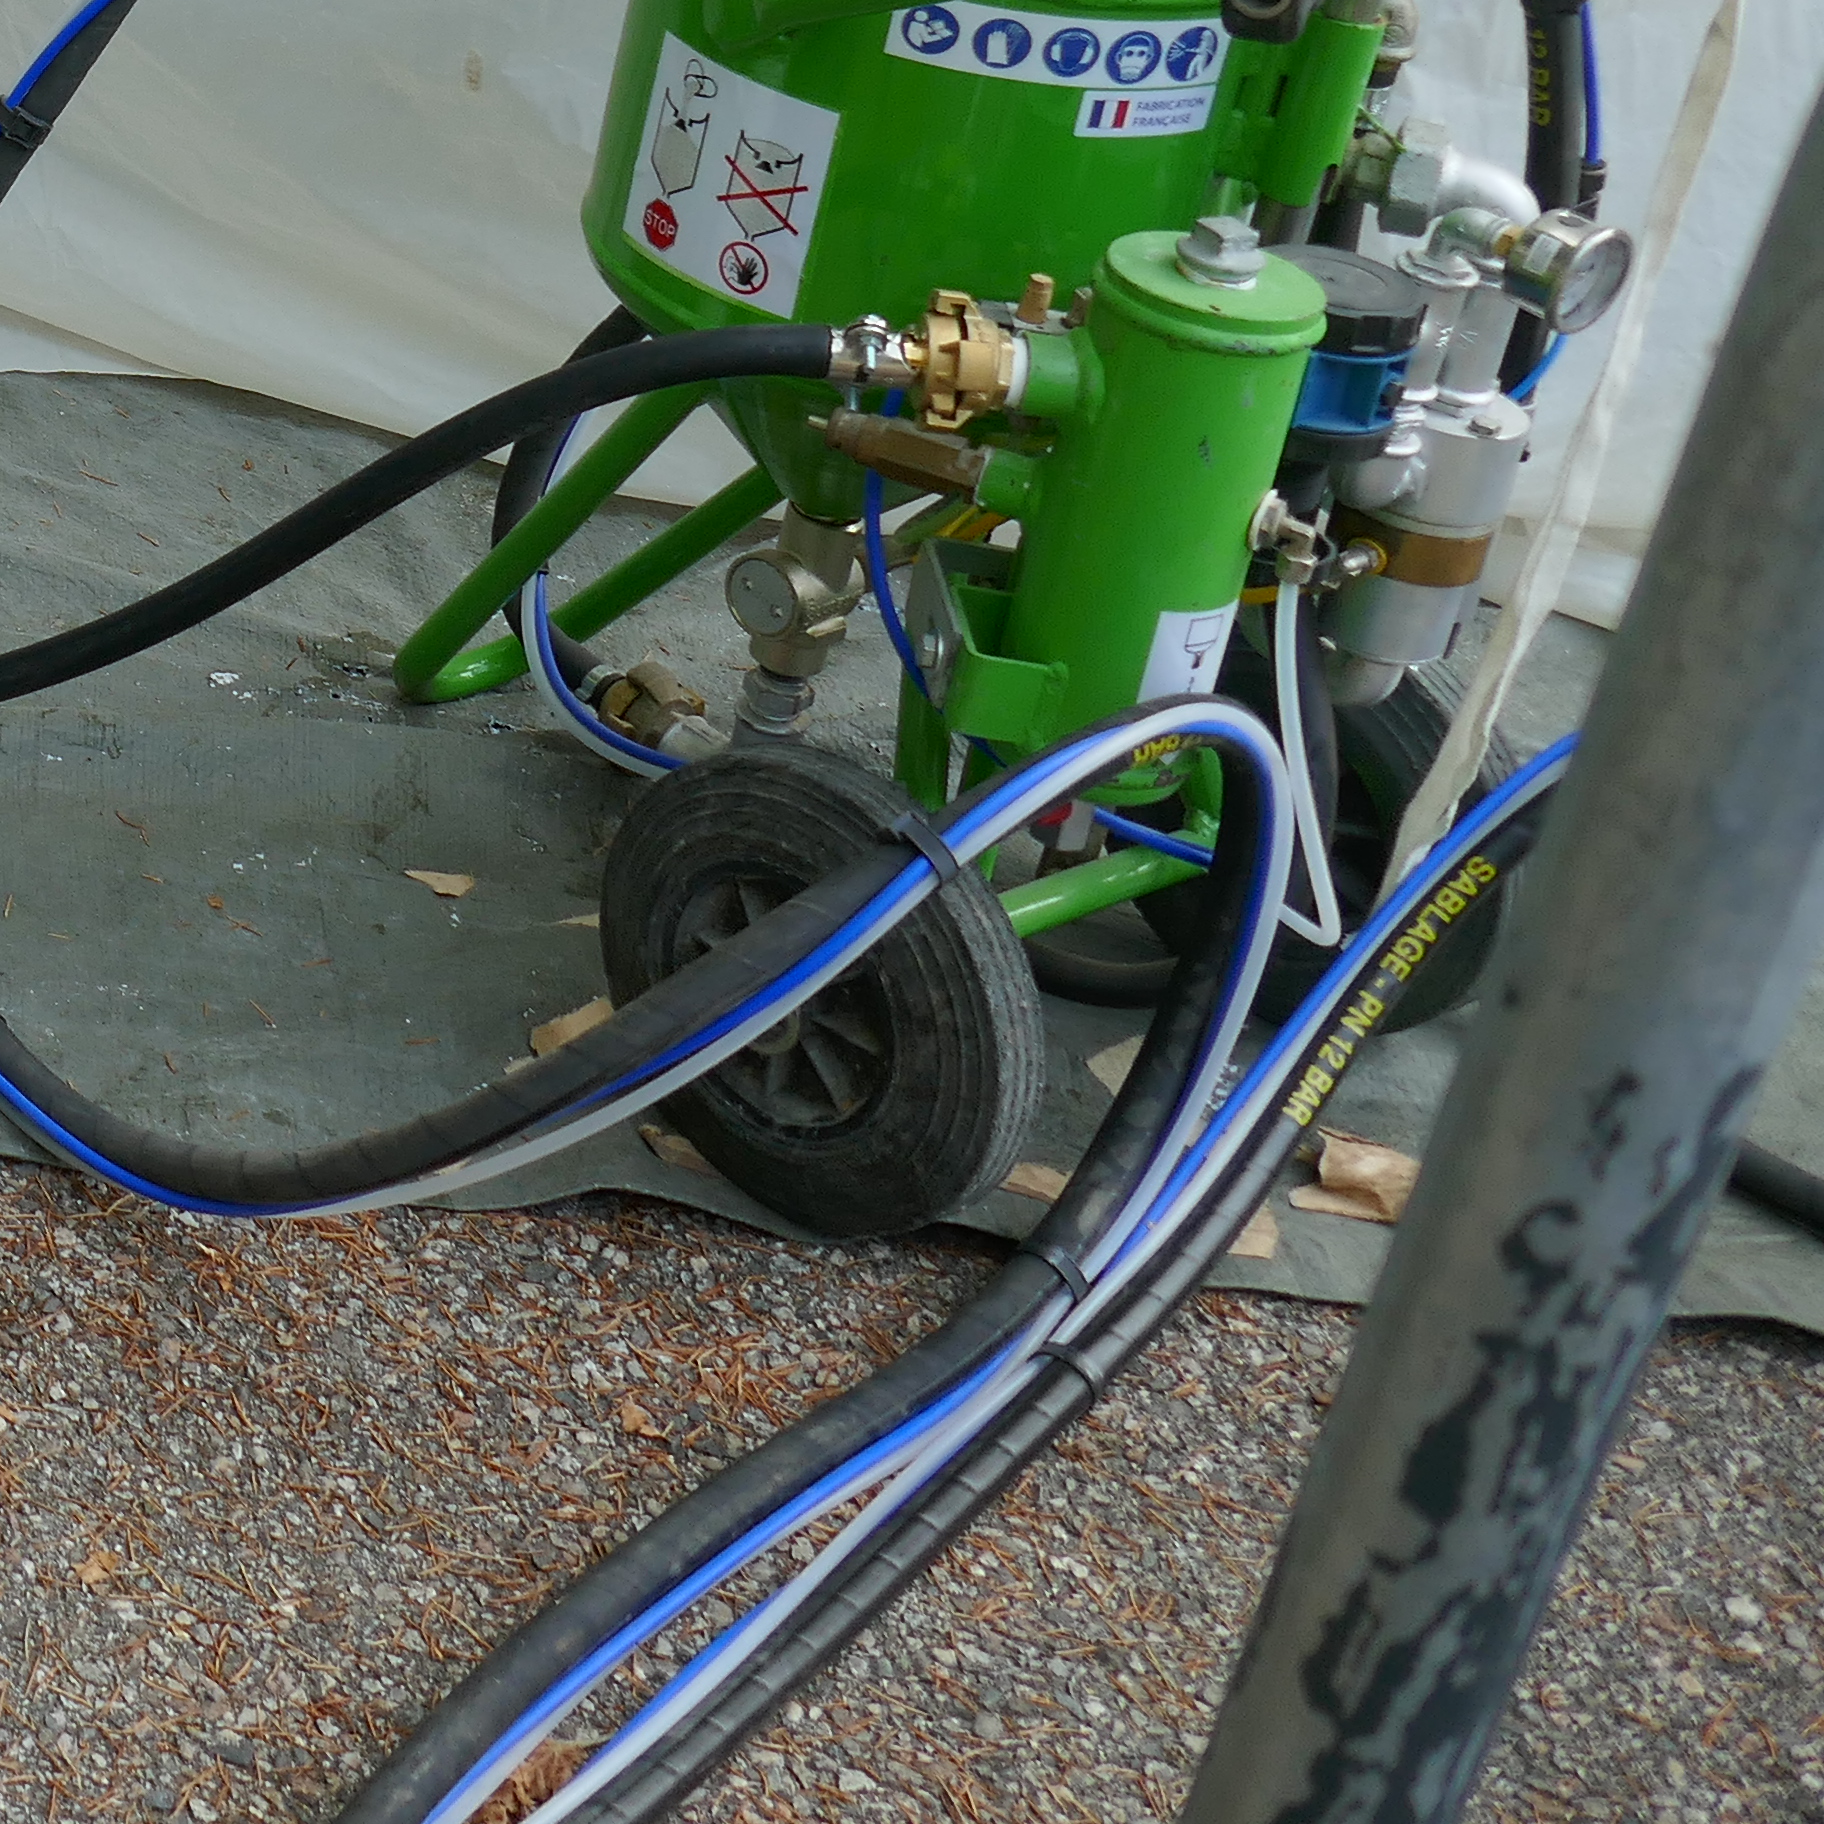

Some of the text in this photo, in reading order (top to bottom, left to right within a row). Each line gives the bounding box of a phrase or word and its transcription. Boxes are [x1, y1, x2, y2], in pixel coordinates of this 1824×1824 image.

[644, 209, 675, 237] STOP
[1378, 854, 1499, 983] SABLAGE
[1339, 989, 1386, 1039] PN
[1316, 1033, 1355, 1071] 12
[1281, 1066, 1336, 1127] BAR
